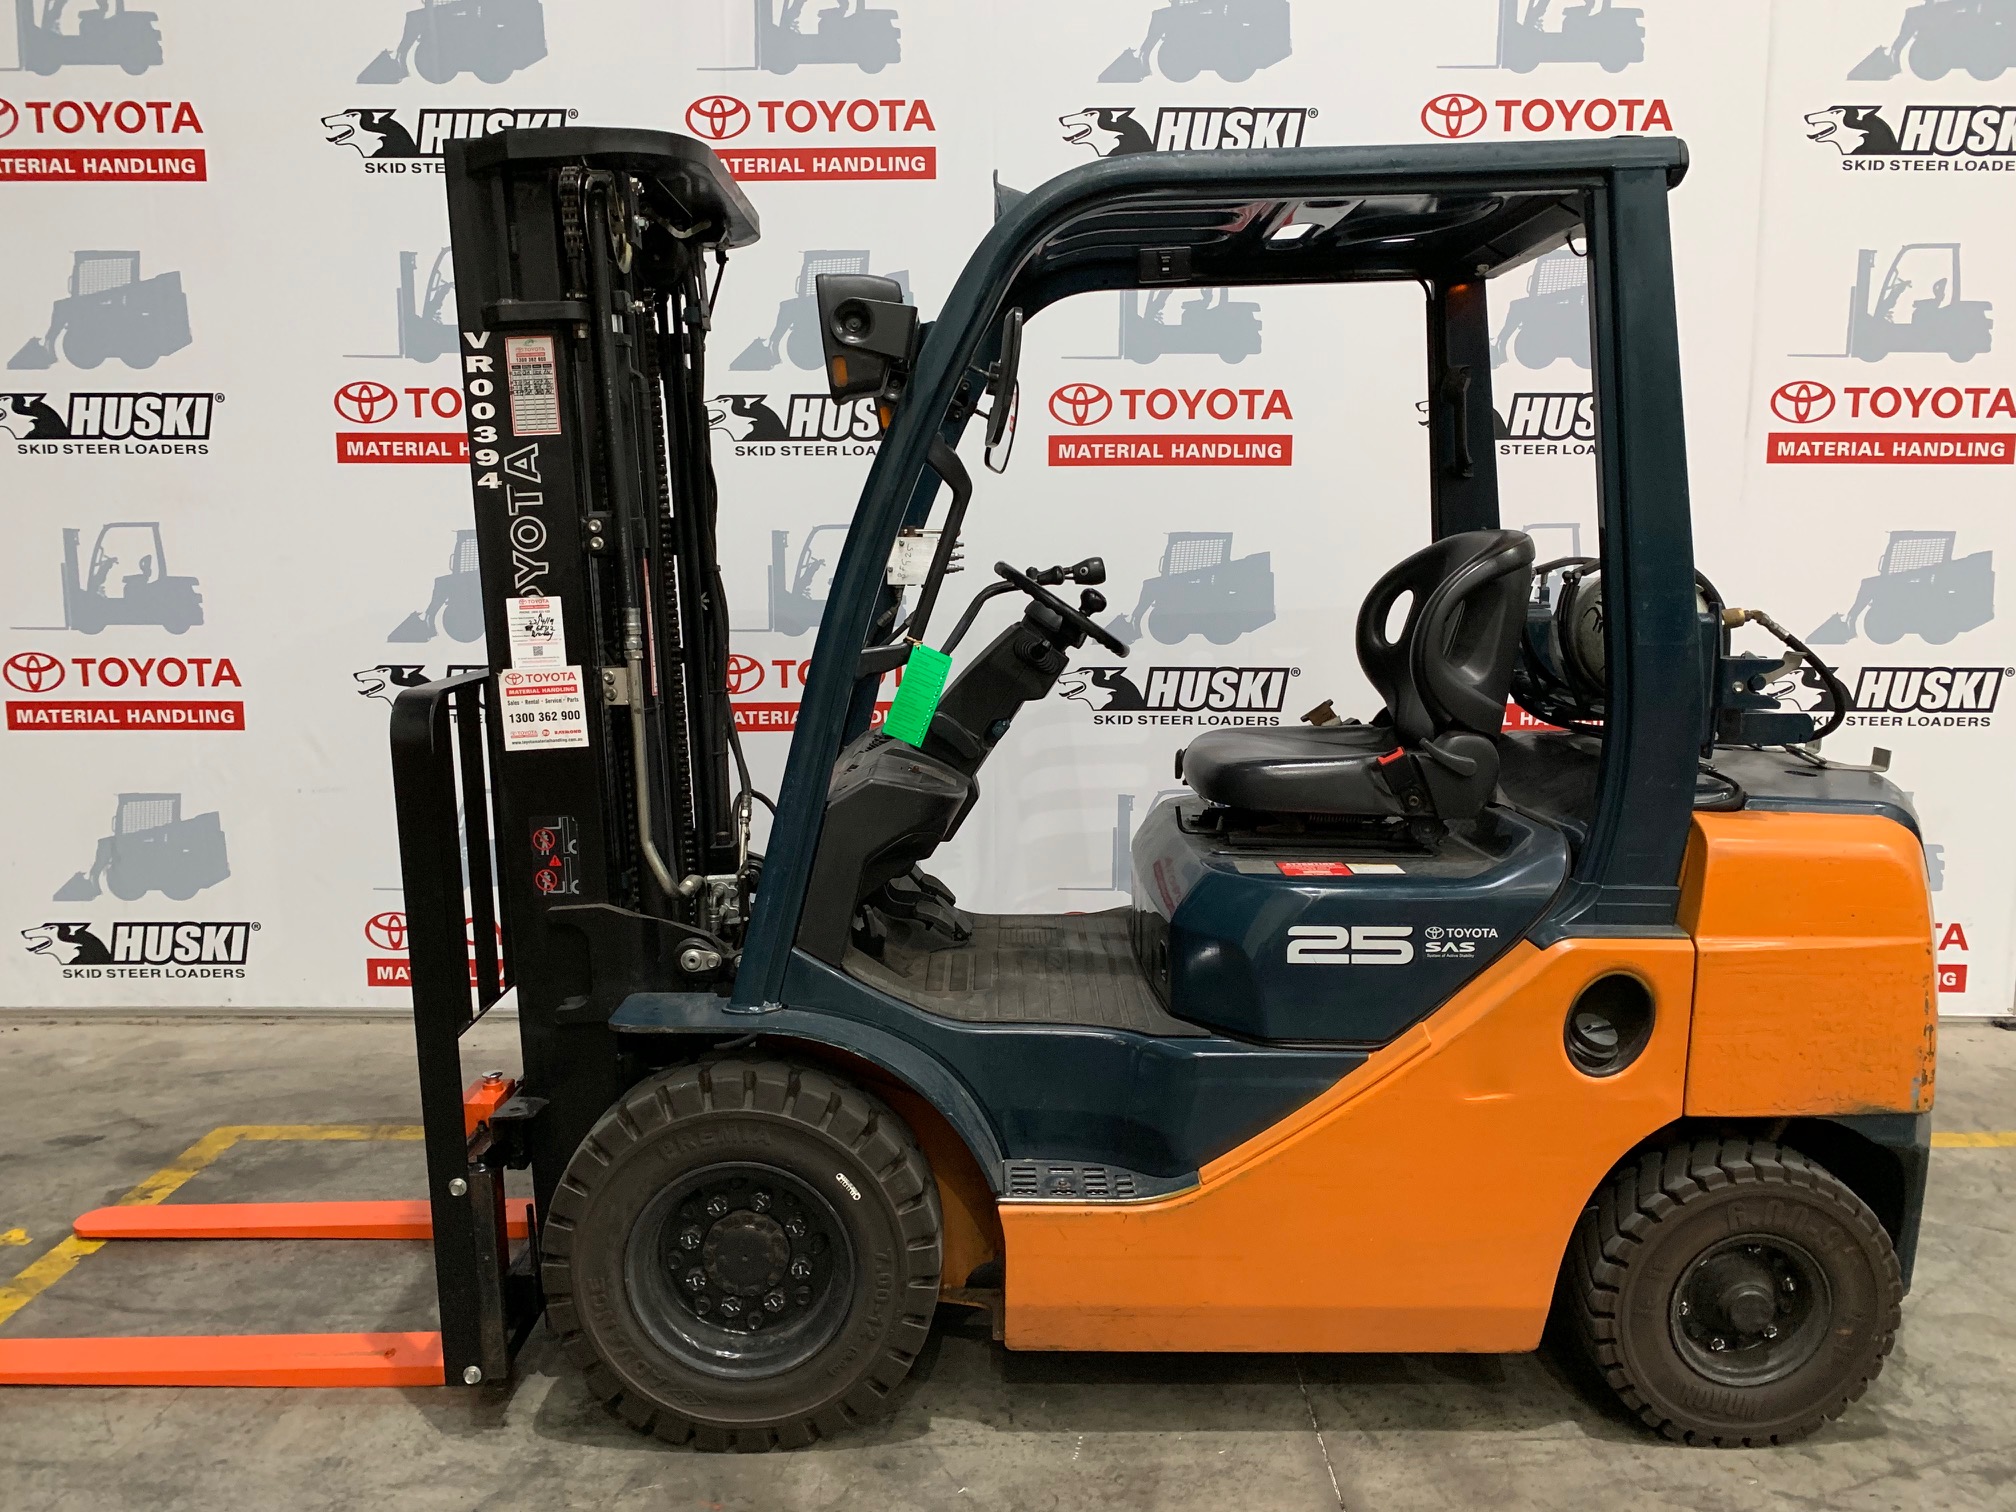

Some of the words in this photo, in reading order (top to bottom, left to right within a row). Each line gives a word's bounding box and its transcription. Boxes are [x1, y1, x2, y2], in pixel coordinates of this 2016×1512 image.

[25, 101, 204, 133] TOYOTA
[758, 99, 936, 132] TOYOTA
[1495, 98, 1673, 131] TOYOTA
[1156, 111, 1302, 149] HUSKI
[1900, 108, 2016, 153] HUSK
[0, 158, 77, 174] TERIAL
[83, 158, 196, 174] HANDLING
[365, 162, 406, 174] SKID
[411, 162, 446, 174] STE
[720, 157, 805, 174] TERIAL
[813, 156, 926, 173] HANDLING
[1842, 160, 1885, 171] SKID
[1890, 160, 1949, 171] STEER
[1954, 160, 2016, 171] LOADE
[463, 331, 503, 489] VR00394
[1120, 388, 1293, 420] TOYOTA
[1844, 387, 2016, 418] TOYOTA
[70, 396, 211, 438] HUSKI
[789, 397, 880, 440] HUS
[17, 444, 59, 455] SKID
[63, 444, 120, 455] STEER
[125, 444, 210, 455] LOADERS
[346, 441, 452, 456] MATERIAL
[735, 445, 776, 456] SKID
[780, 445, 838, 456] STEER
[1058, 443, 1164, 459] MATERIAL
[1171, 443, 1282, 459] HANDLING
[1500, 444, 1558, 455] STEER
[1777, 441, 1885, 457] MATERIAL
[1892, 441, 2005, 457] HANDLING
[504, 443, 549, 597] YOTA
[71, 657, 242, 687] TOYOTA
[525, 672, 576, 682] TOYOTA
[1146, 670, 1287, 709] HUSKI
[1856, 670, 2000, 710] HUSKI
[15, 709, 120, 724] MATERIAL
[127, 709, 235, 724] HANDLING
[509, 712, 535, 723] 1300
[538, 711, 558, 722] 362
[561, 710, 581, 721] 900
[733, 710, 799, 725] ATERI
[1093, 715, 1133, 726] SKID
[1137, 715, 1194, 726] STEER
[1197, 715, 1280, 726] LOADERS
[1845, 716, 1903, 727] STEER
[1907, 716, 1991, 727] LOADERS
[1446, 928, 1499, 938] TOYOTA
[113, 924, 247, 963] HUSKI
[1287, 926, 1415, 965] 25
[1425, 941, 1476, 953] SAS
[63, 968, 102, 979] SKID
[106, 968, 161, 979] STEER
[165, 968, 246, 979] LOADERS
